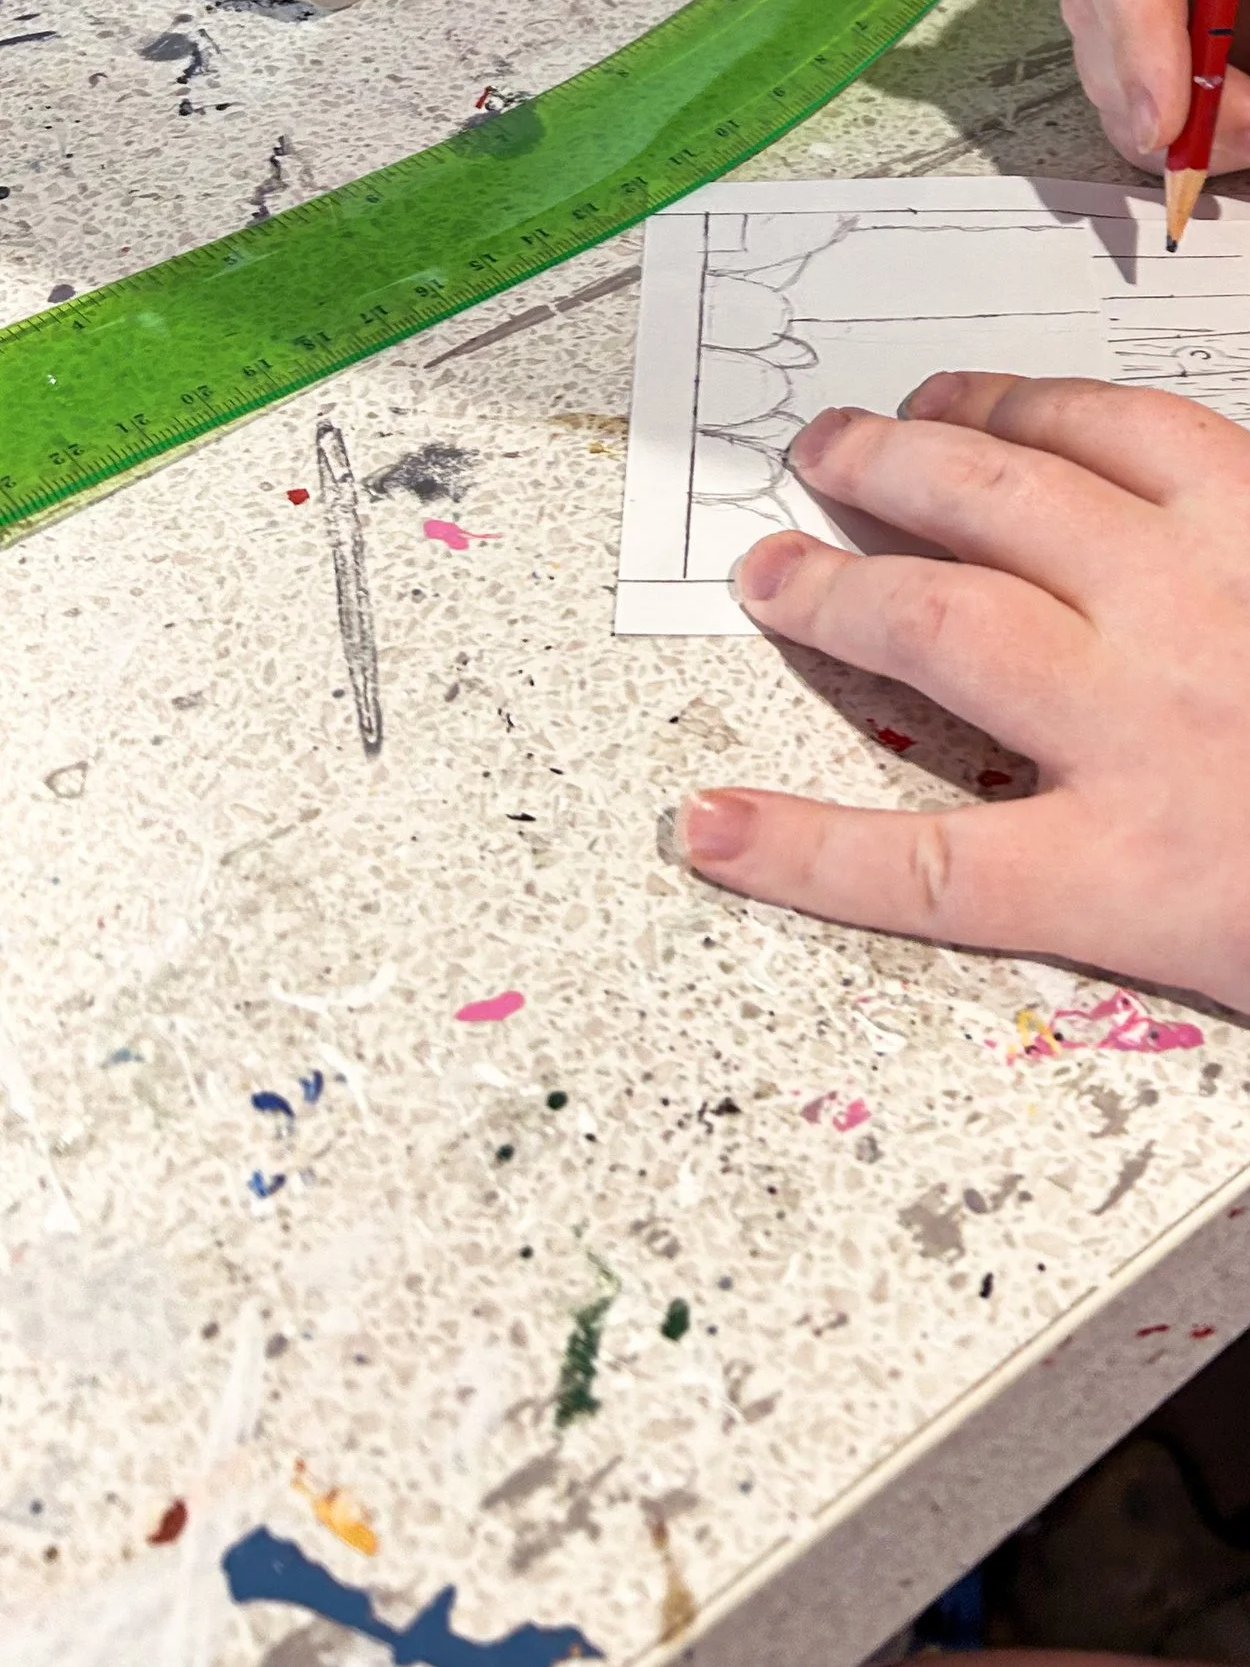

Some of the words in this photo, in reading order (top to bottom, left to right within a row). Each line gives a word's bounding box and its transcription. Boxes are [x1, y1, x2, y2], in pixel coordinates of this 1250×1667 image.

[855, 20, 869, 31] 7
[813, 54, 828, 65] 8
[772, 86, 786, 98] 9
[714, 119, 740, 137] 10
[668, 149, 698, 166] 11
[620, 175, 648, 193] 12
[571, 202, 600, 220] 13
[520, 227, 550, 245] 14
[468, 252, 498, 272] 15
[414, 278, 445, 298] 16
[359, 304, 389, 325] 17
[301, 331, 332, 351] 18
[242, 357, 273, 378] 19
[180, 384, 213, 406] 20
[114, 412, 150, 434] 21
[48, 443, 85, 466] 22
